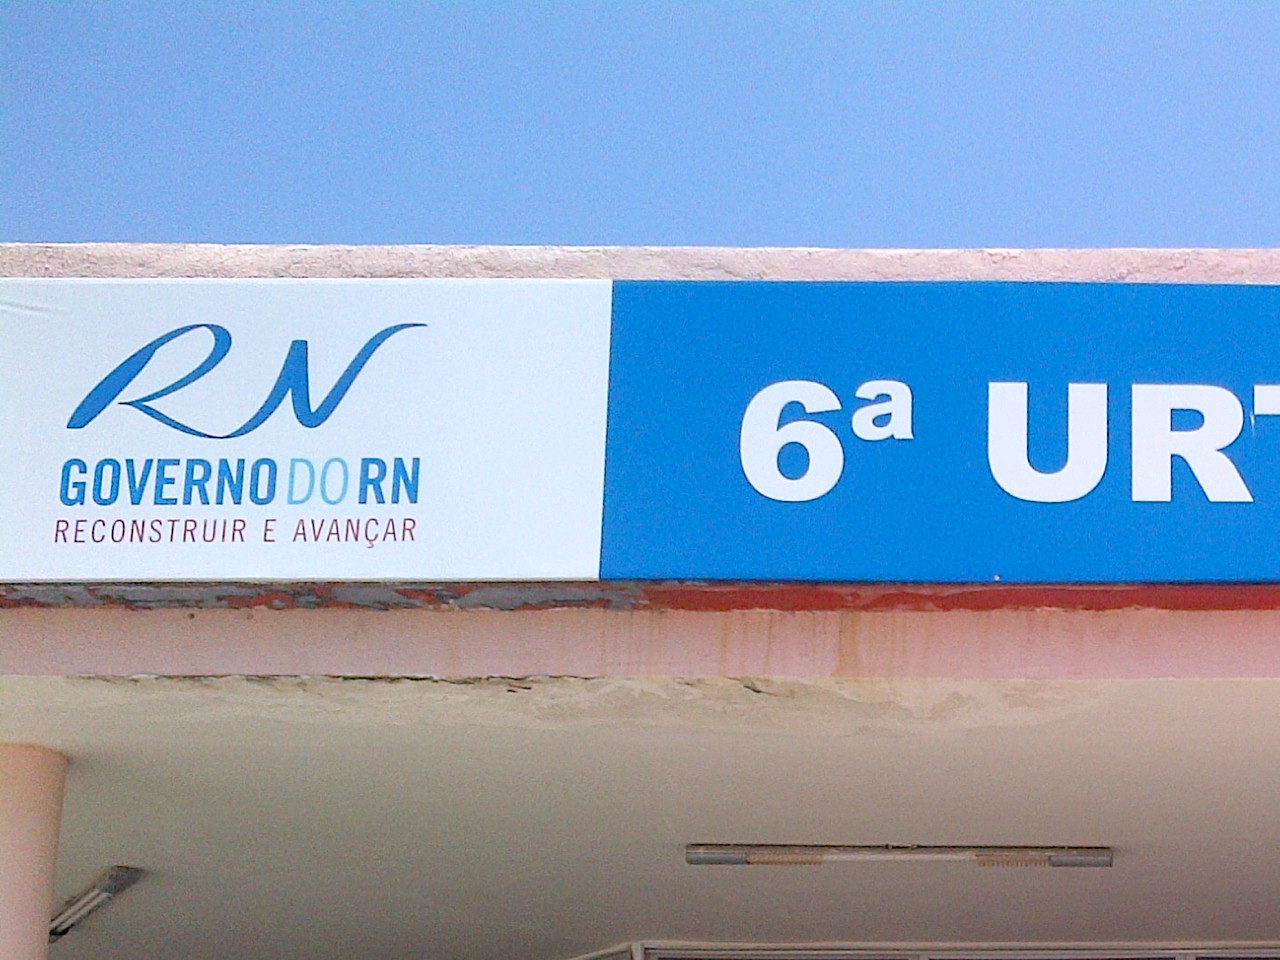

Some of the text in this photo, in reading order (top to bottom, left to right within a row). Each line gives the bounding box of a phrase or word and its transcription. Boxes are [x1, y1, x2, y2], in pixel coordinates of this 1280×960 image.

[58, 456, 421, 507] GOVERNO DO RN
[54, 517, 417, 548] RECONSTRUIR E AVANÇAR
